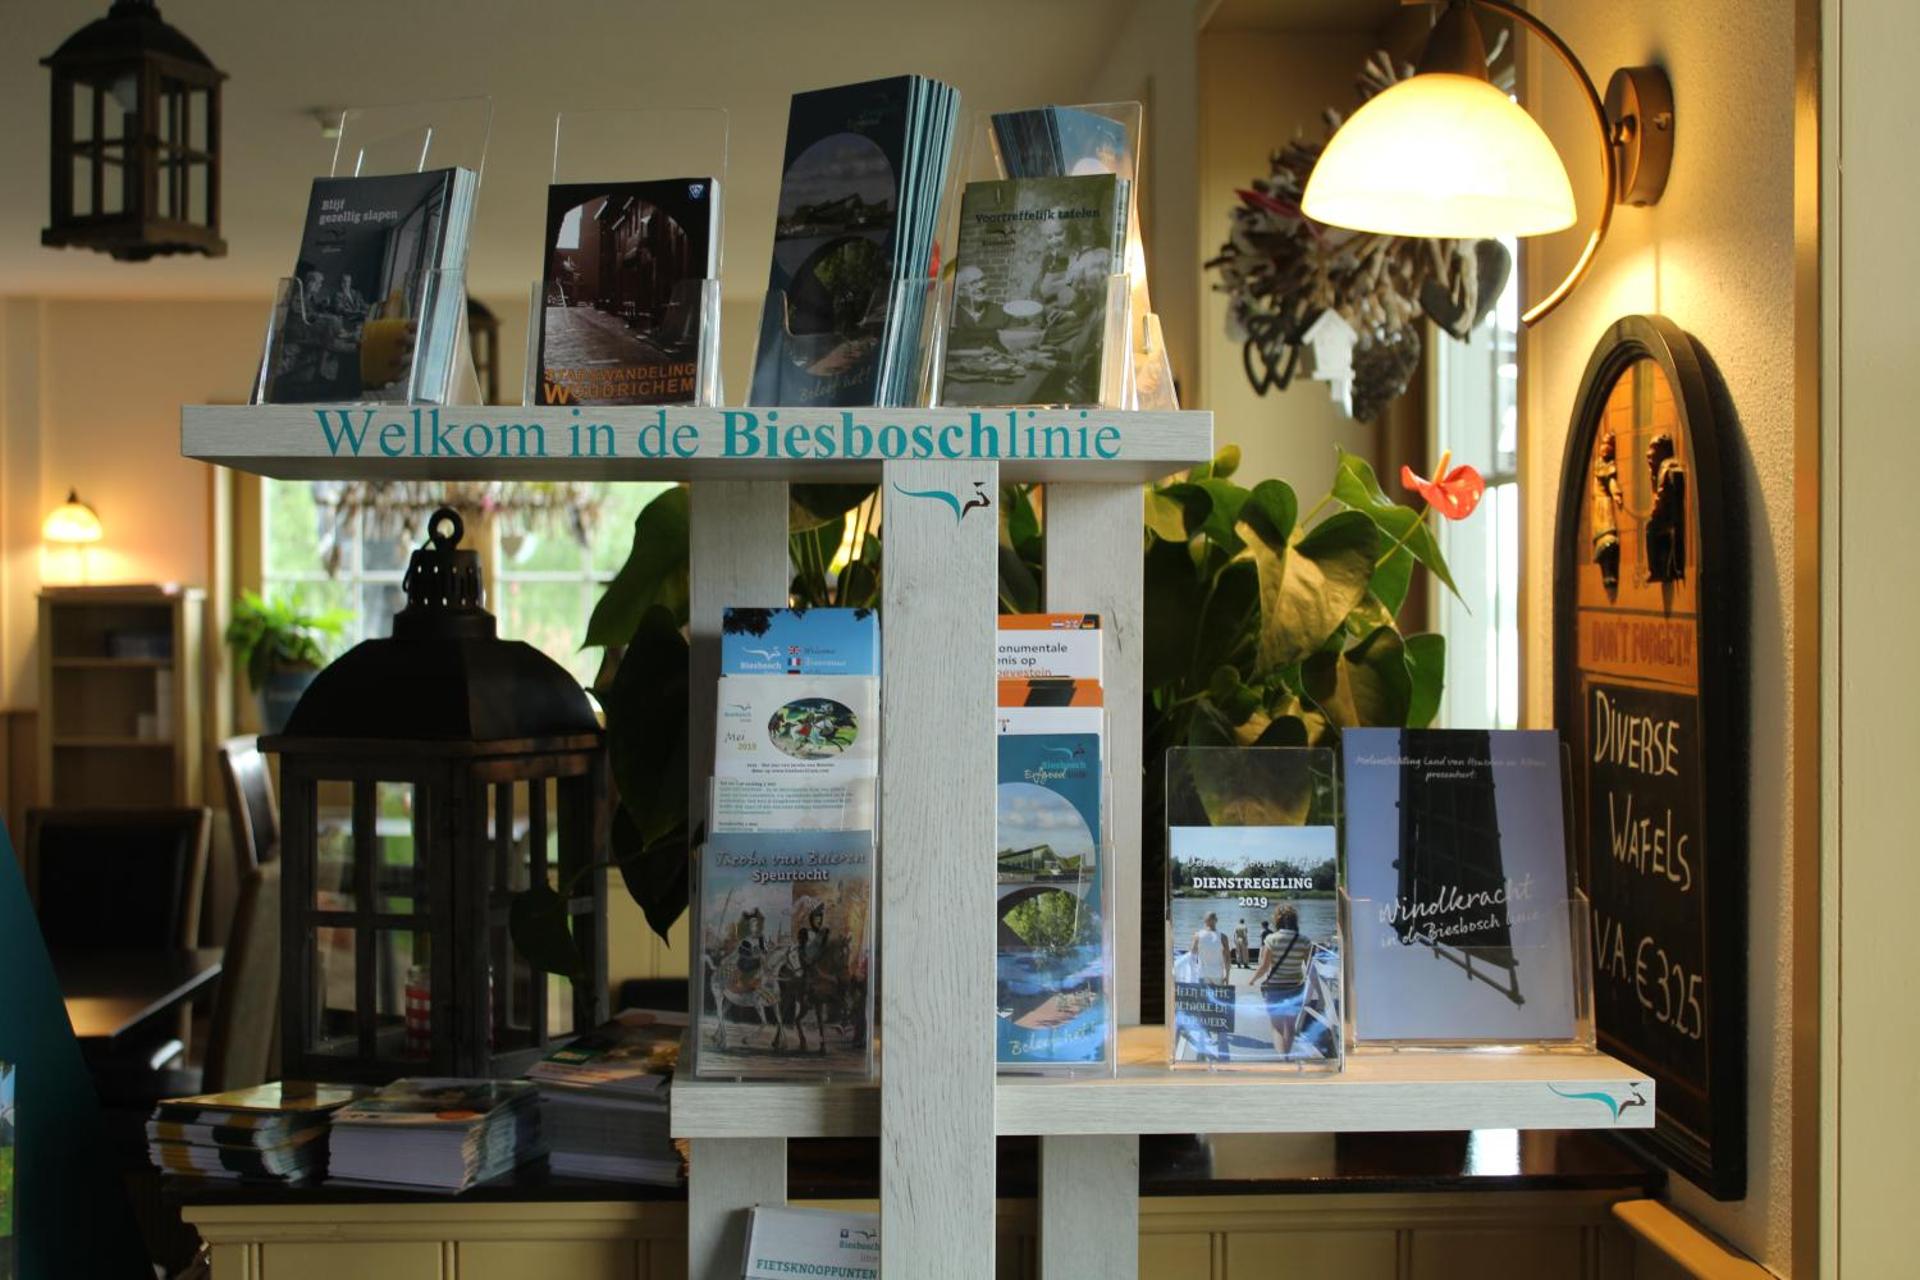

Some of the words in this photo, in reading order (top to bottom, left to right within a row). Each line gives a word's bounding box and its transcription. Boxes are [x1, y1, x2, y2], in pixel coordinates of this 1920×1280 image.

[319, 211, 361, 225] gezellig
[362, 209, 399, 223] slapen
[976, 208, 1055, 224] Voortreffelijk
[1058, 207, 1101, 221] tafelen
[315, 408, 549, 458] Welkom
[568, 408, 618, 458] in
[638, 408, 700, 458] de
[719, 410, 1121, 459] Biesboschlinie
[1021, 656, 1037, 667] op
[1608, 790, 1692, 893] WAFELS
[752, 868, 829, 884] Speurtocht
[1193, 877, 1313, 890] DIENSTREGELING
[1238, 896, 1268, 909] 2019
[1379, 873, 1535, 924] Windkracht
[1422, 912, 1501, 940] Biesbosch
[756, 1258, 877, 1279] FIETSKNOOPPUNTEN
